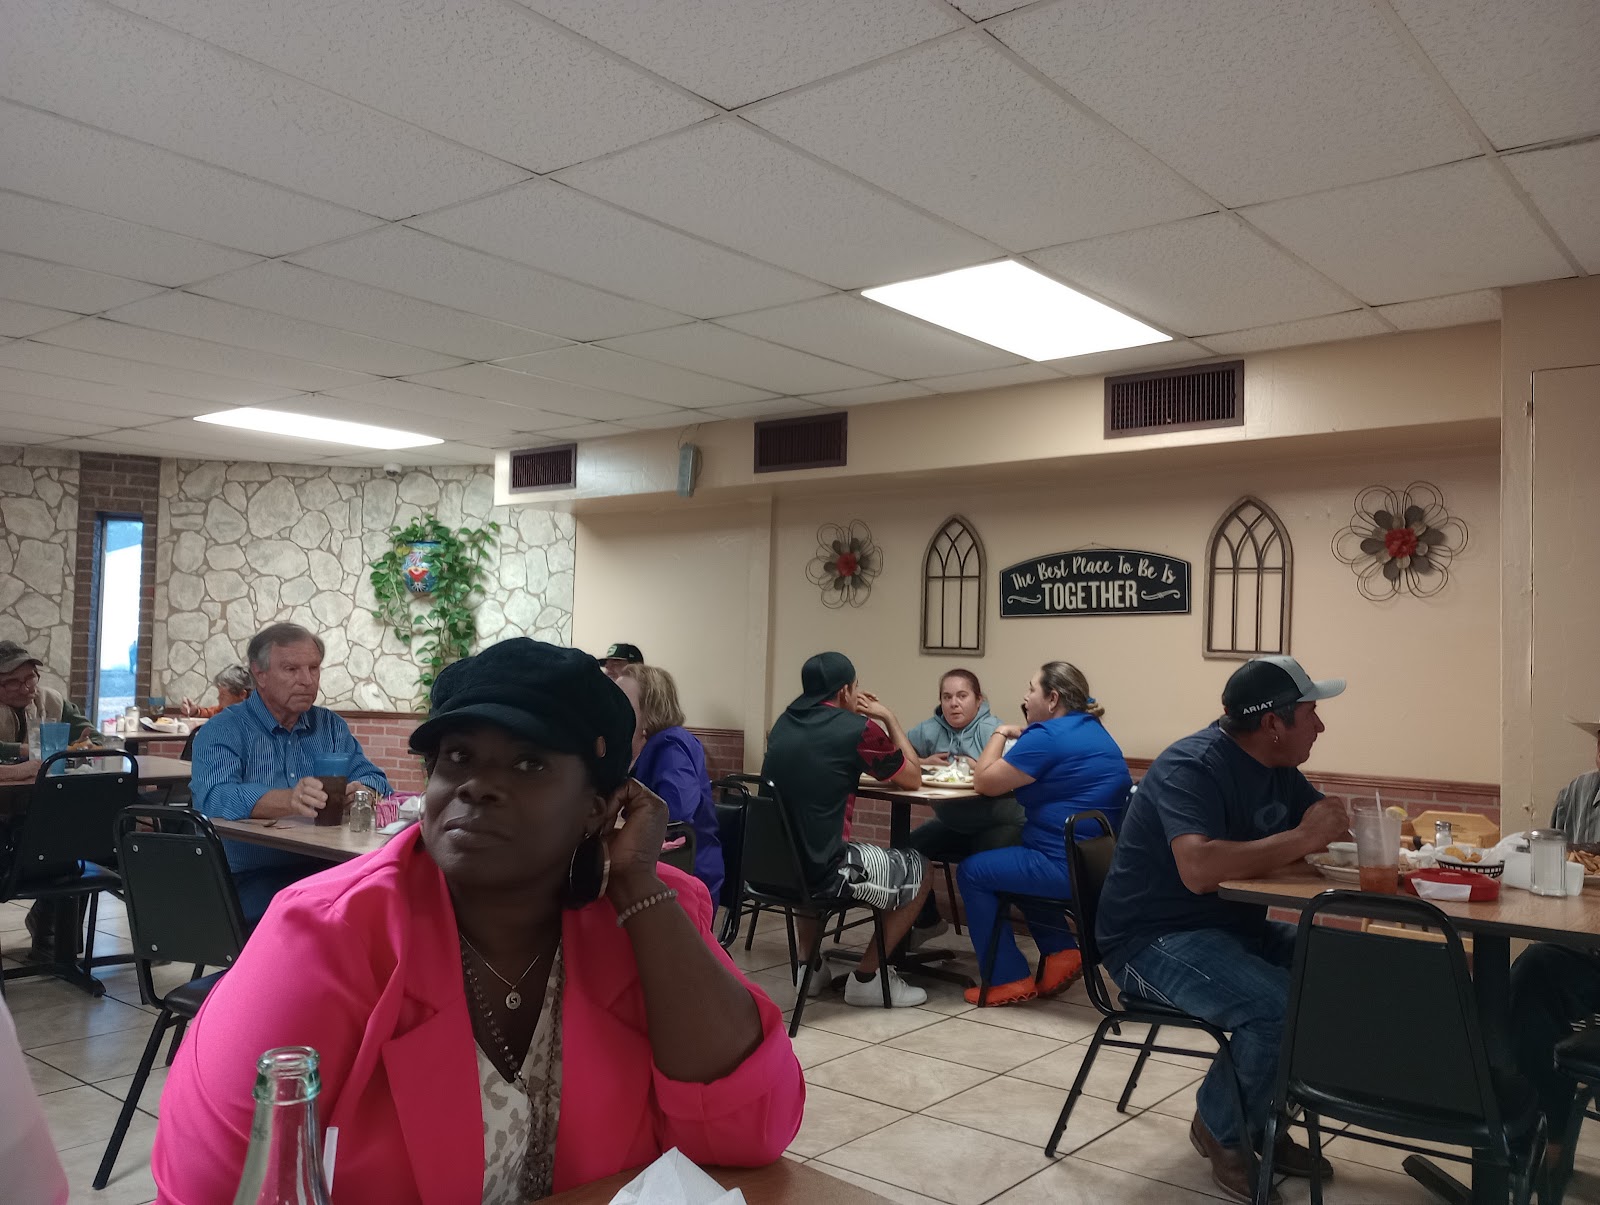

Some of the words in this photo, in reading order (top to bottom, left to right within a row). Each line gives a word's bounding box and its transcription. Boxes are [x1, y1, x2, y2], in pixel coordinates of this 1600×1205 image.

[1010, 573, 1036, 590] The
[1037, 559, 1069, 581] Best
[1072, 556, 1113, 575] Place
[1118, 555, 1134, 575] To
[1137, 558, 1158, 579] Be
[1160, 563, 1176, 584] Is
[1041, 579, 1138, 611] TOGETHER
[1242, 700, 1274, 715] ARIAT
